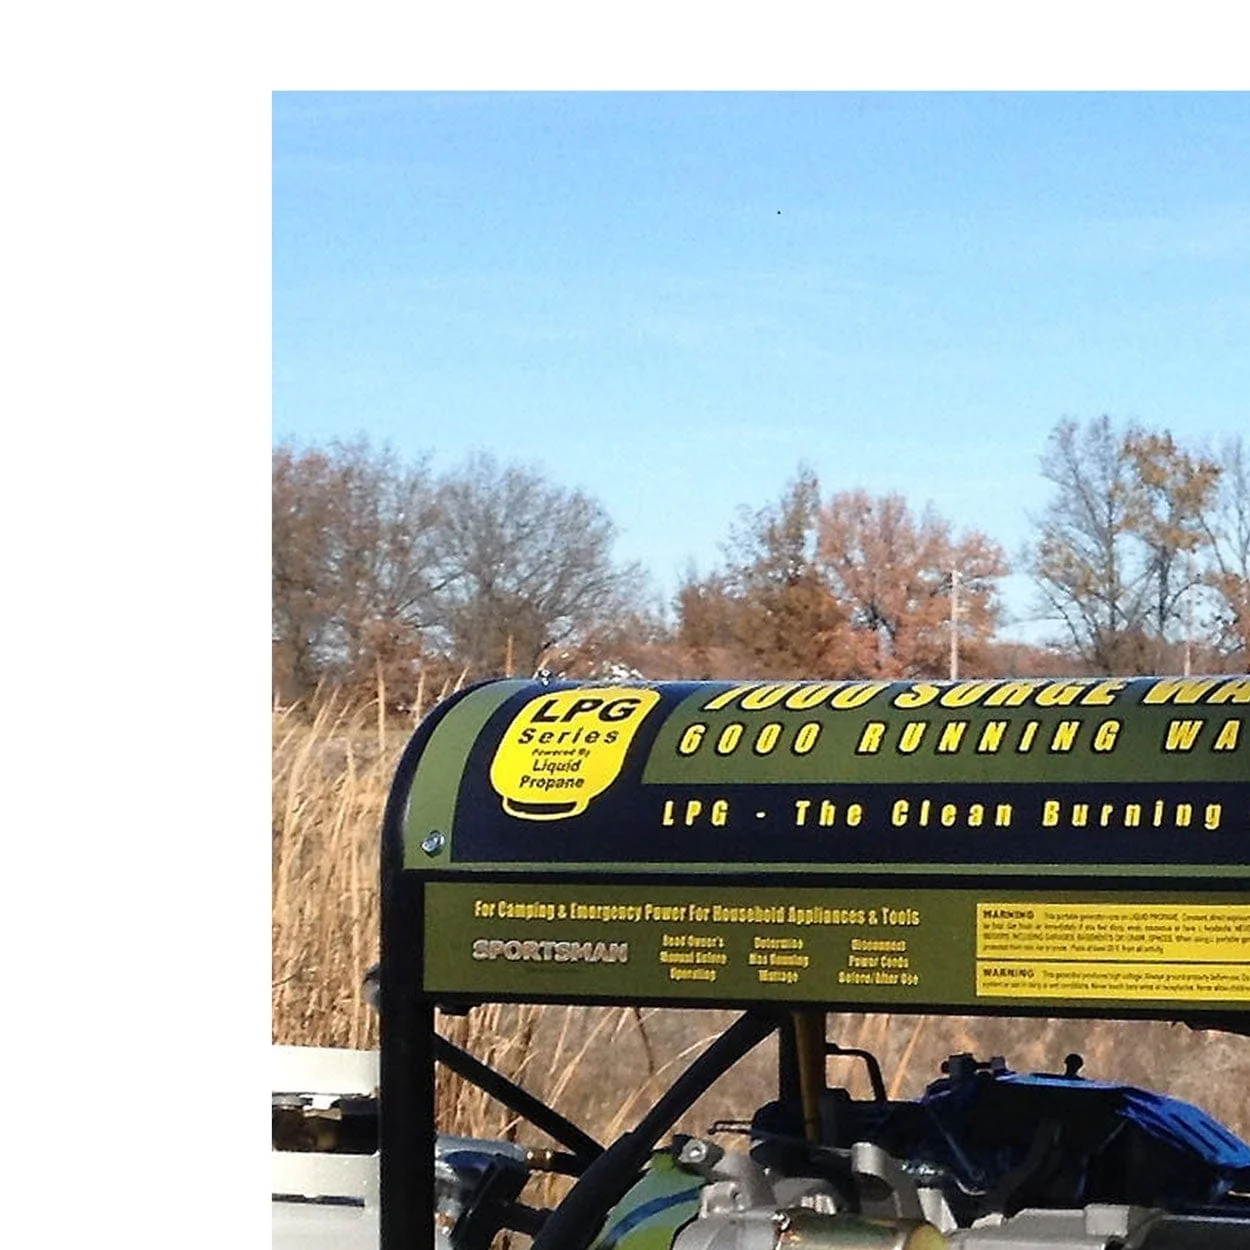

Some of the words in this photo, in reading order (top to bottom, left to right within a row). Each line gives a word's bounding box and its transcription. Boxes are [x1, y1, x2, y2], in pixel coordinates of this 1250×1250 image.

[893, 681, 1127, 709] SURGE
[531, 697, 641, 723] LPG
[518, 727, 620, 744] Series
[680, 722, 821, 754] 6000
[858, 720, 1121, 753] RUNNING
[532, 759, 582, 774] Liquid
[519, 774, 585, 791] Propane
[662, 799, 729, 827] LPG
[795, 799, 863, 827] The
[892, 799, 1013, 827] Clean
[1042, 799, 1222, 830] Burning
[474, 900, 496, 918] For
[498, 901, 555, 921] Camping
[557, 904, 567, 919] &
[570, 902, 642, 922] Emergency
[644, 903, 686, 921] Power
[688, 904, 710, 922] For
[712, 904, 785, 924] Household
[787, 905, 866, 925] Appliances
[868, 909, 878, 925] &
[881, 907, 920, 926] Tools
[472, 939, 628, 963] SPORTSMAN
[982, 968, 1035, 978] WARNING
